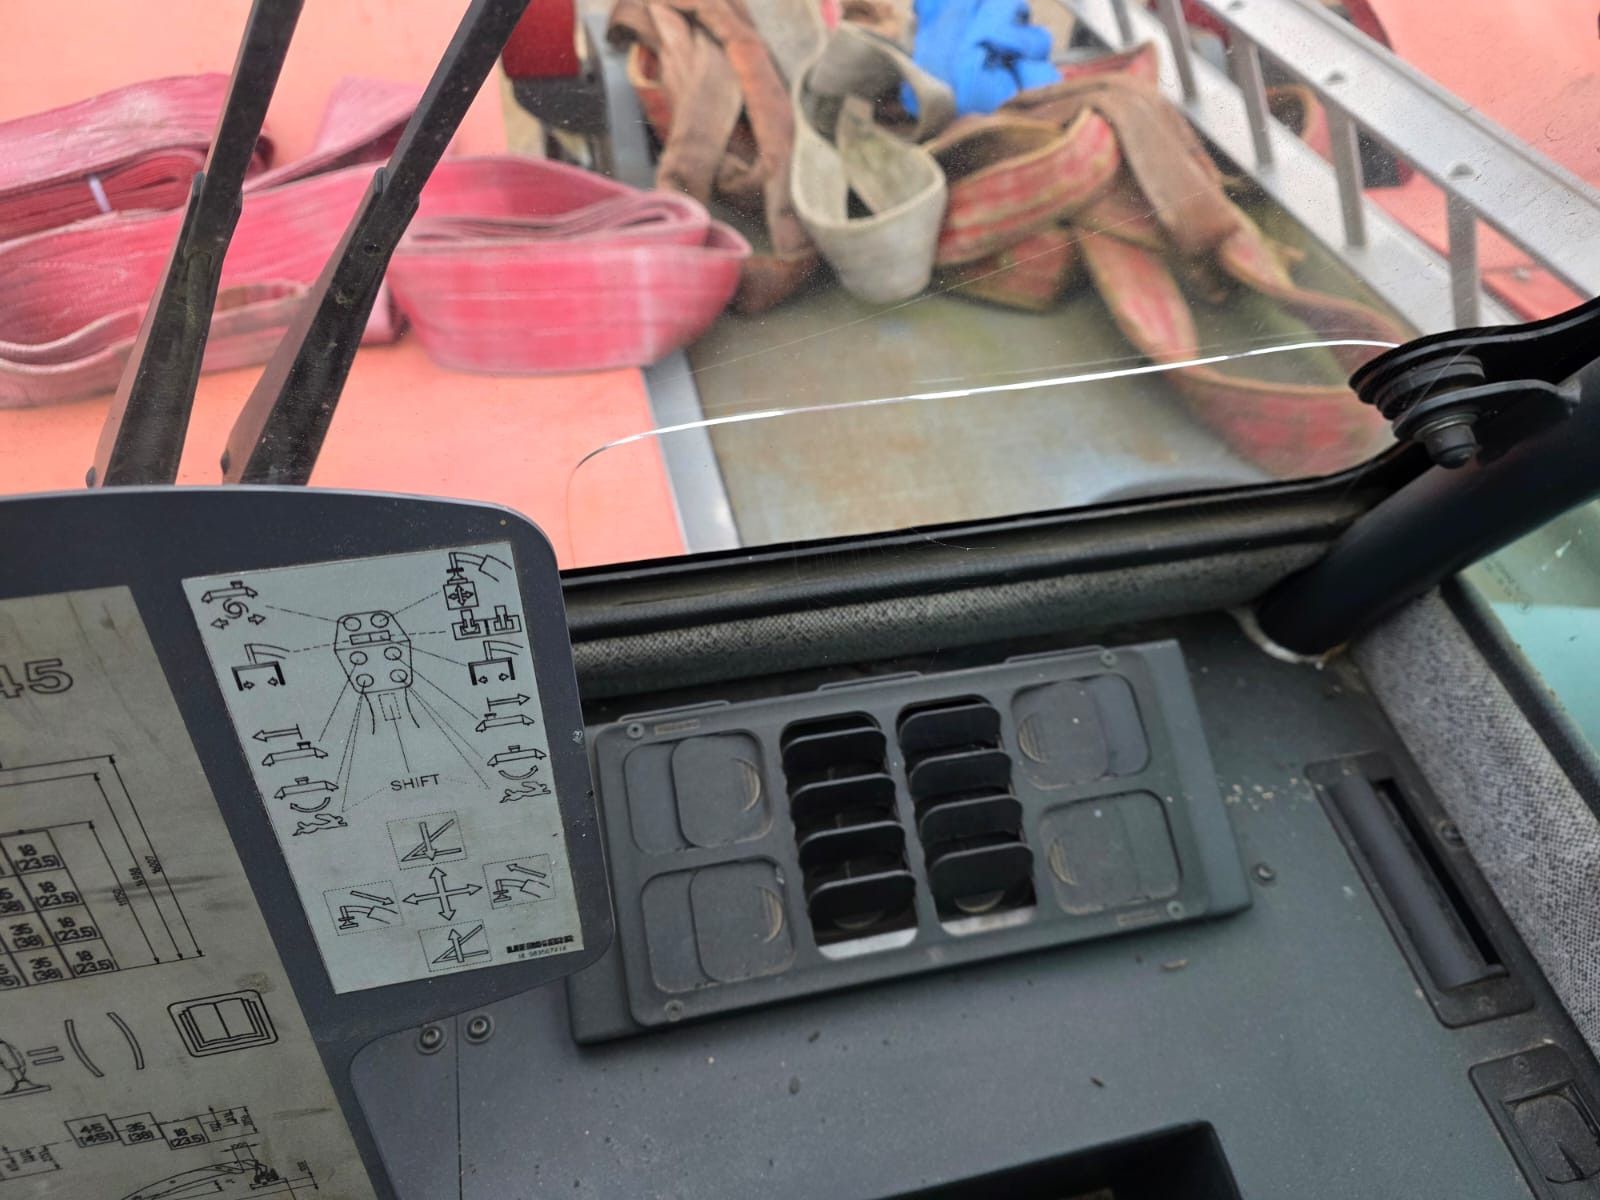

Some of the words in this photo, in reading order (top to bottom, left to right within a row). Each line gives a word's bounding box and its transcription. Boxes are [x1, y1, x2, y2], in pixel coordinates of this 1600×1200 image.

[390, 773, 440, 791] SHIFT
[18, 844, 37, 856] 18
[15, 855, 60, 872] (23.5)
[0, 887, 13, 899] 5
[38, 881, 57, 893] 18
[0, 899, 26, 913] 38)
[35, 891, 80, 908] (23.5)
[57, 917, 75, 928] 18
[9, 923, 33, 936] 35
[54, 926, 97, 942] (23.5)
[13, 935, 45, 949] (38)
[29, 957, 52, 969] 35
[76, 951, 93, 962] 18
[73, 959, 115, 976] (23.5)
[33, 968, 63, 981] (38)
[126, 1122, 146, 1132] 35
[173, 1128, 188, 1137] 18
[128, 1130, 154, 1142] (38)
[170, 1134, 206, 1147] (23.5)
